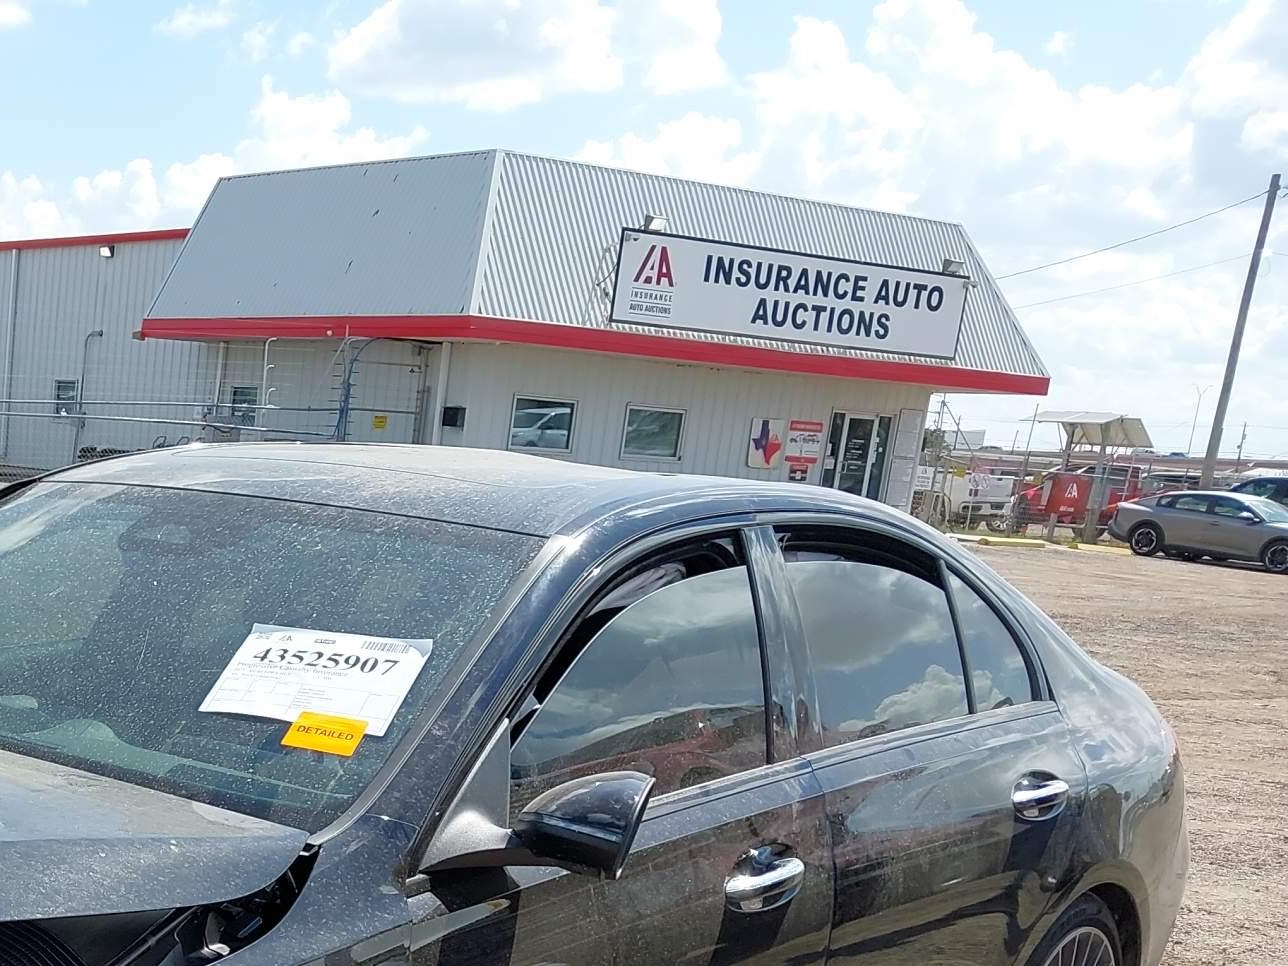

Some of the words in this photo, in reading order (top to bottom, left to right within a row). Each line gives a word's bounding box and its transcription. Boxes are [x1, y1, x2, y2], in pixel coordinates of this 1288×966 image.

[704, 255, 868, 301] INSURANCE
[874, 278, 944, 312] AUTO
[630, 290, 673, 303] INSURANCE
[629, 303, 644, 312] AUTO
[644, 304, 672, 315] AUCTIONS
[751, 298, 891, 340] AUCTIONS
[253, 647, 400, 675] 43525907
[296, 724, 355, 741] DETAILED
